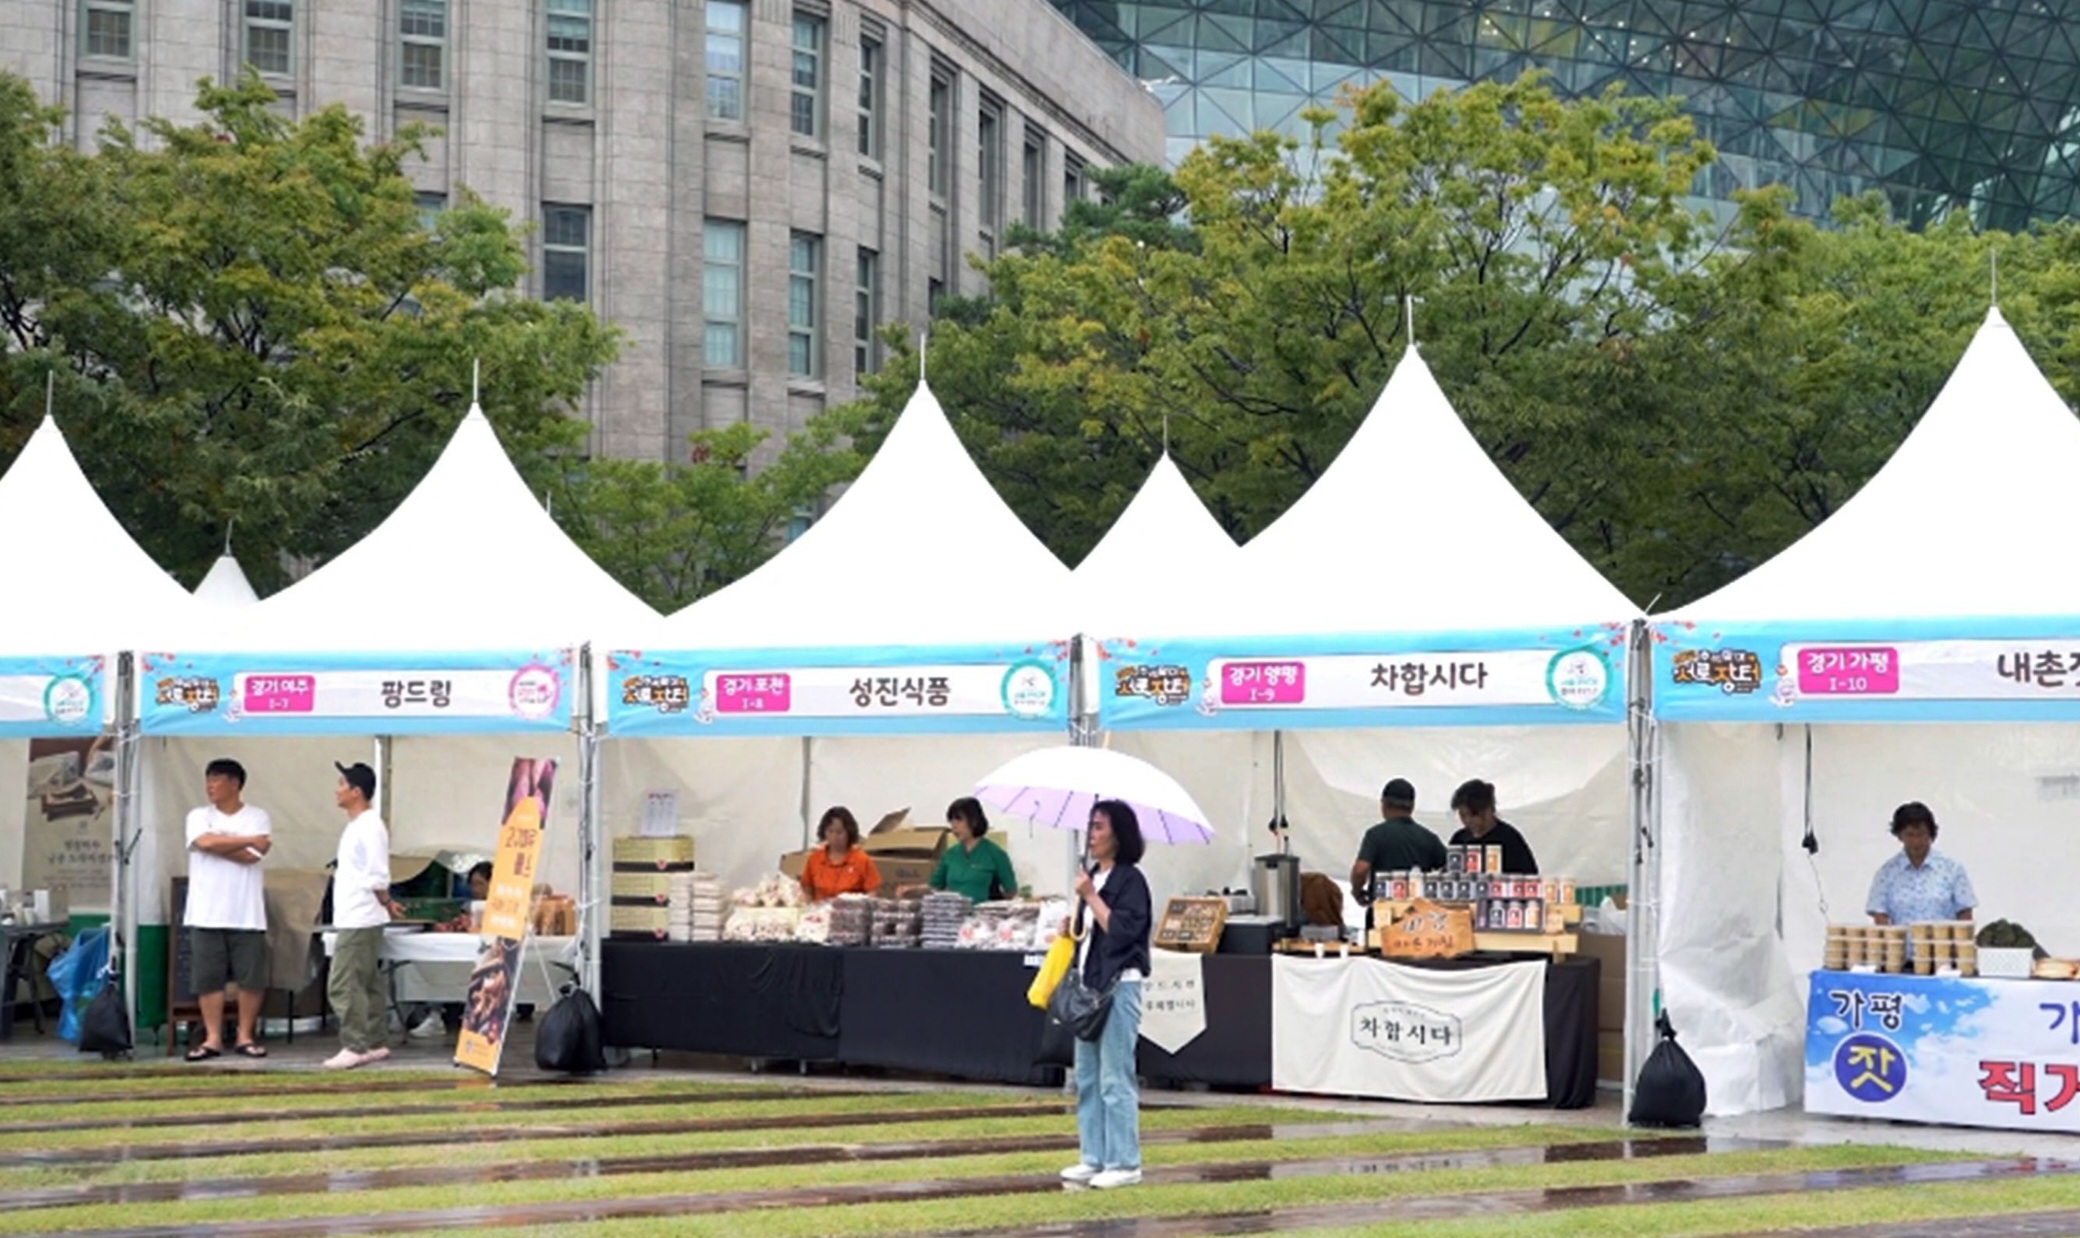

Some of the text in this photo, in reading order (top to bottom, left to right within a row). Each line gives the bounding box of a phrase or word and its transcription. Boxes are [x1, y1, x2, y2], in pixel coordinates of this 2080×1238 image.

[1229, 665, 1298, 686] 경기 양평
[1807, 651, 1888, 674] 경기 가평
[251, 680, 279, 696] 경기
[723, 677, 784, 697] 경기 포천
[849, 677, 951, 707] 성진식품
[1370, 662, 1488, 696] 차합시다
[381, 680, 452, 709] 팡드링
[1830, 991, 1902, 1030] 가평
[1359, 1017, 1452, 1046] 차합시다
[1847, 1046, 1897, 1093] 잣
